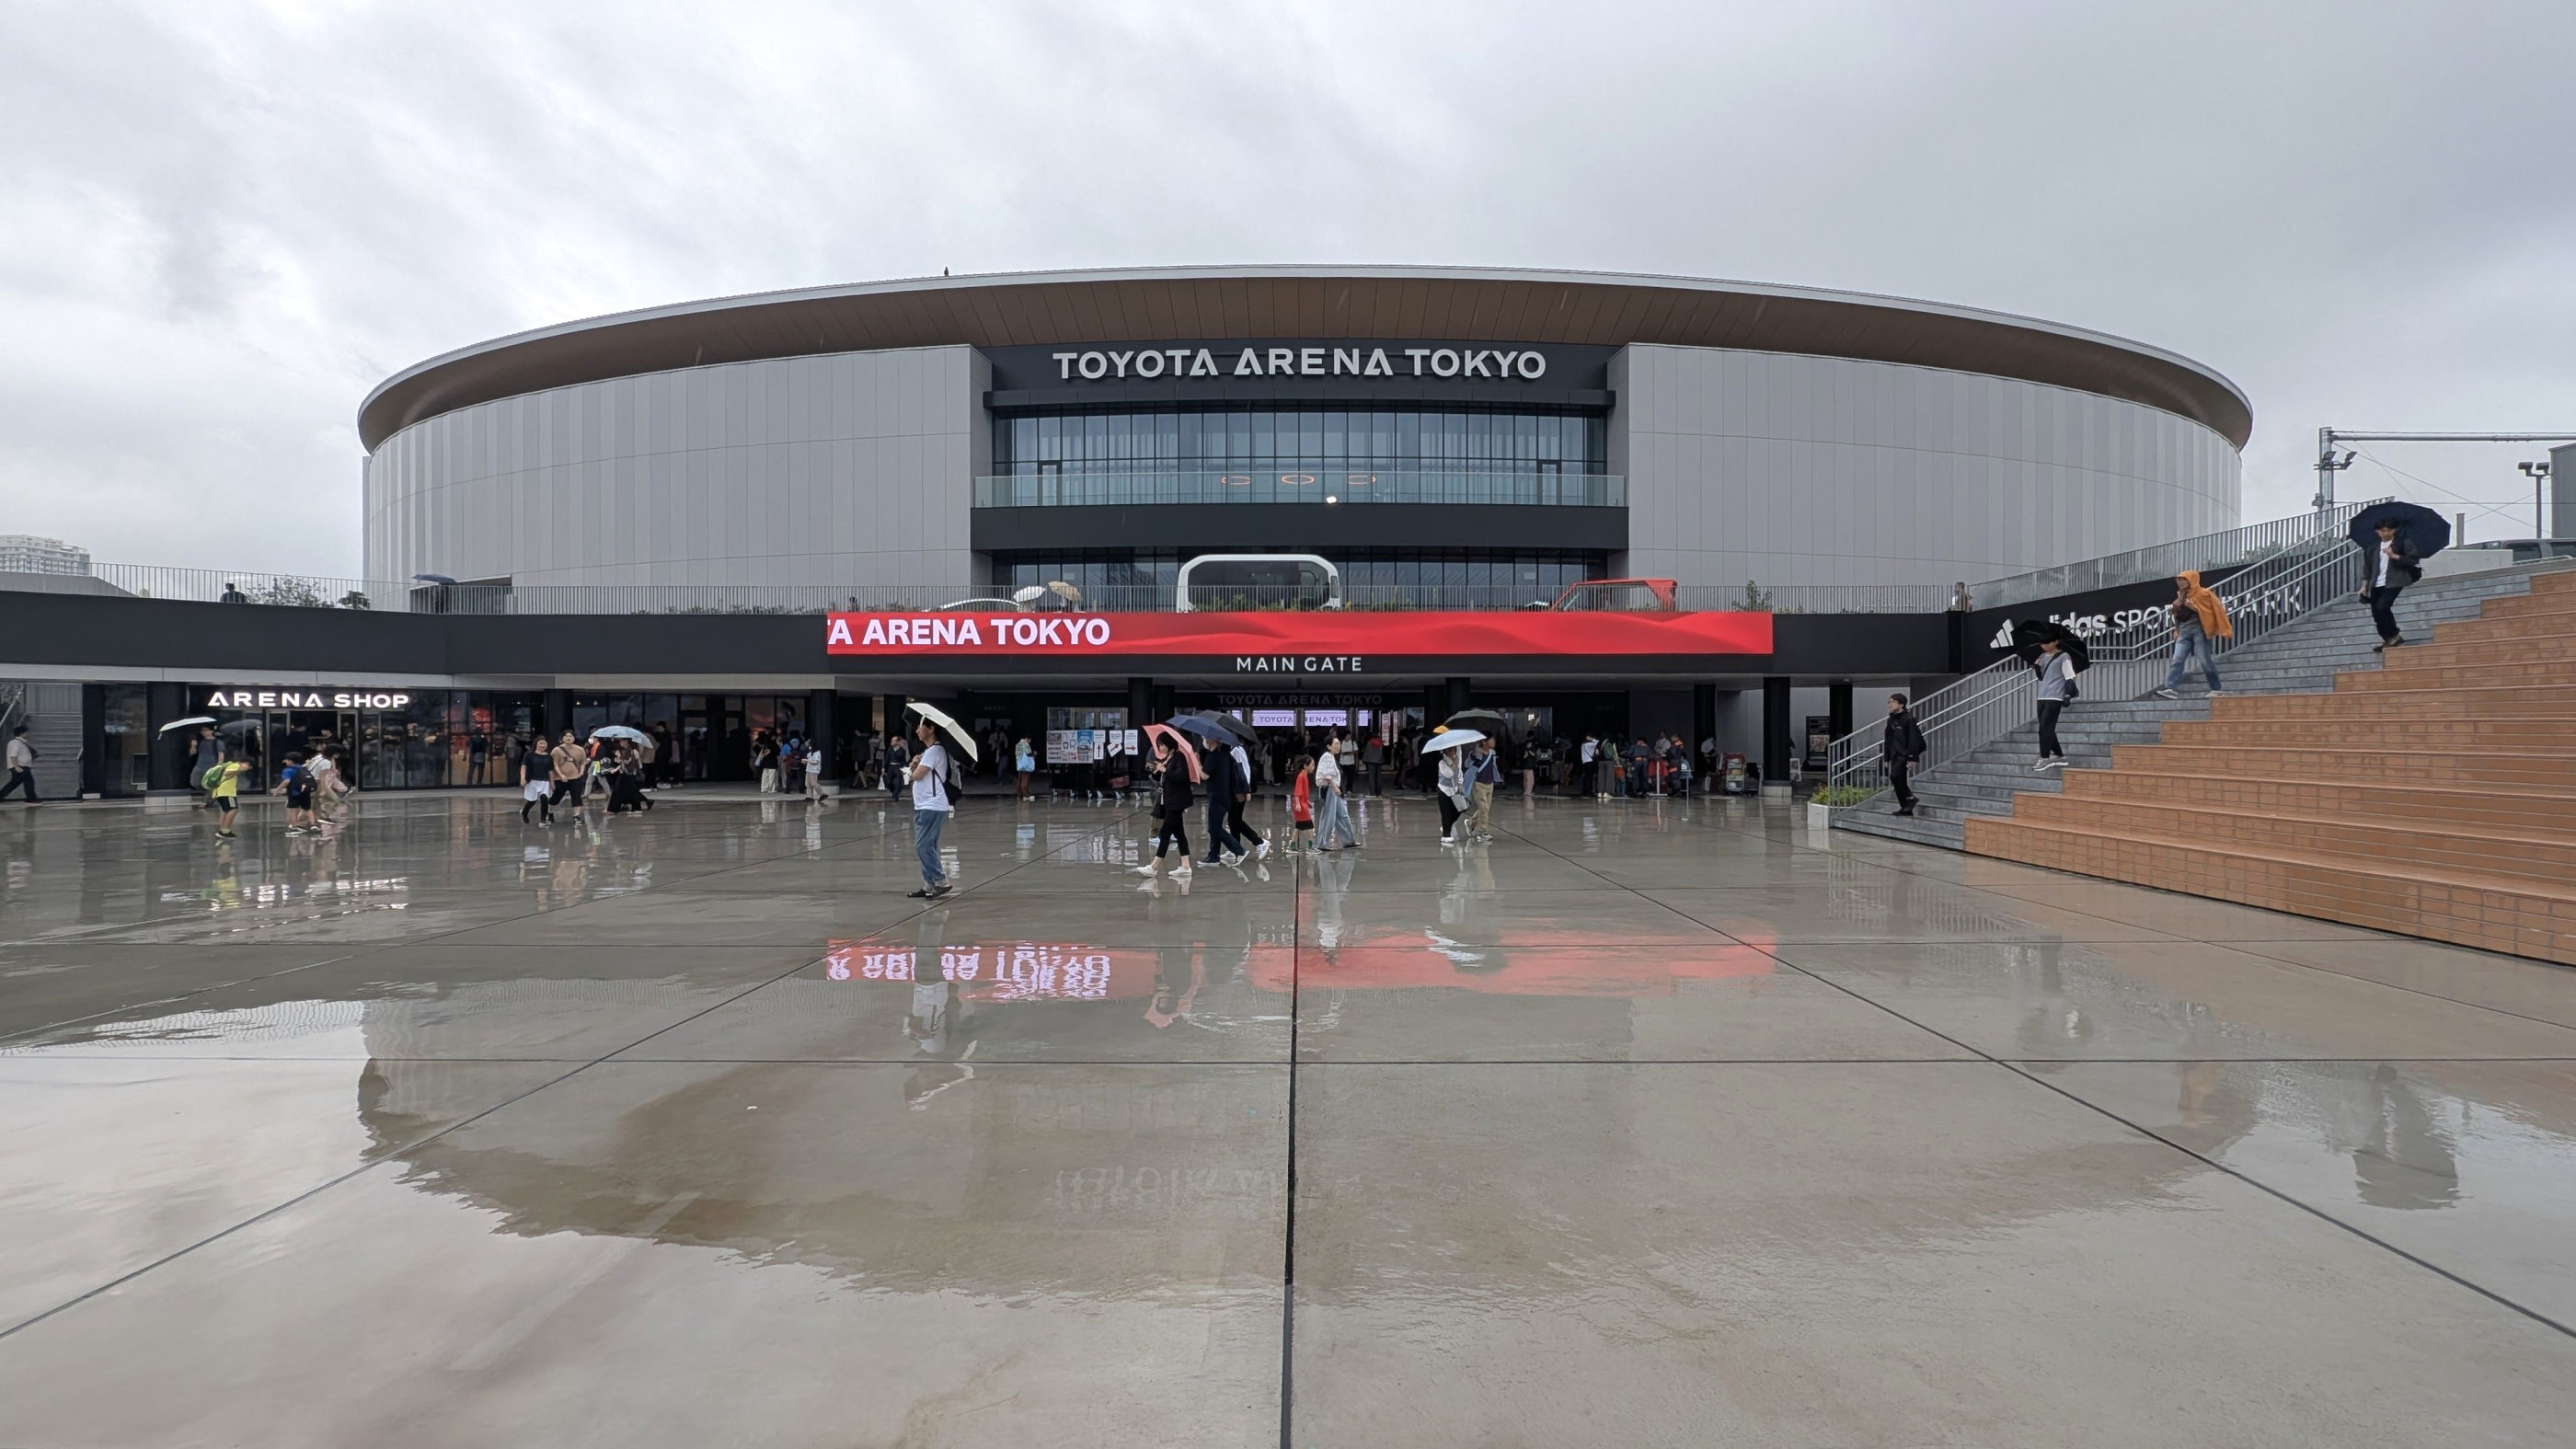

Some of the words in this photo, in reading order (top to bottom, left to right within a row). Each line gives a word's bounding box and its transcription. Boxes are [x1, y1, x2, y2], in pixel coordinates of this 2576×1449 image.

[1052, 348, 1219, 379] TOYOTA
[1233, 347, 1394, 375] ARENA
[1404, 349, 1547, 379] TOKYO
[827, 618, 854, 645] A
[862, 618, 982, 645] ARENA
[990, 618, 1110, 646] TOKYO
[1236, 656, 1294, 672] MAIN
[1304, 656, 1362, 672] GATE
[207, 691, 324, 707] ARENA
[333, 694, 409, 708] SHOP
[1217, 695, 1273, 705] TOYOTA
[1277, 695, 1330, 705] ARENA
[1334, 695, 1382, 705] TOKYO
